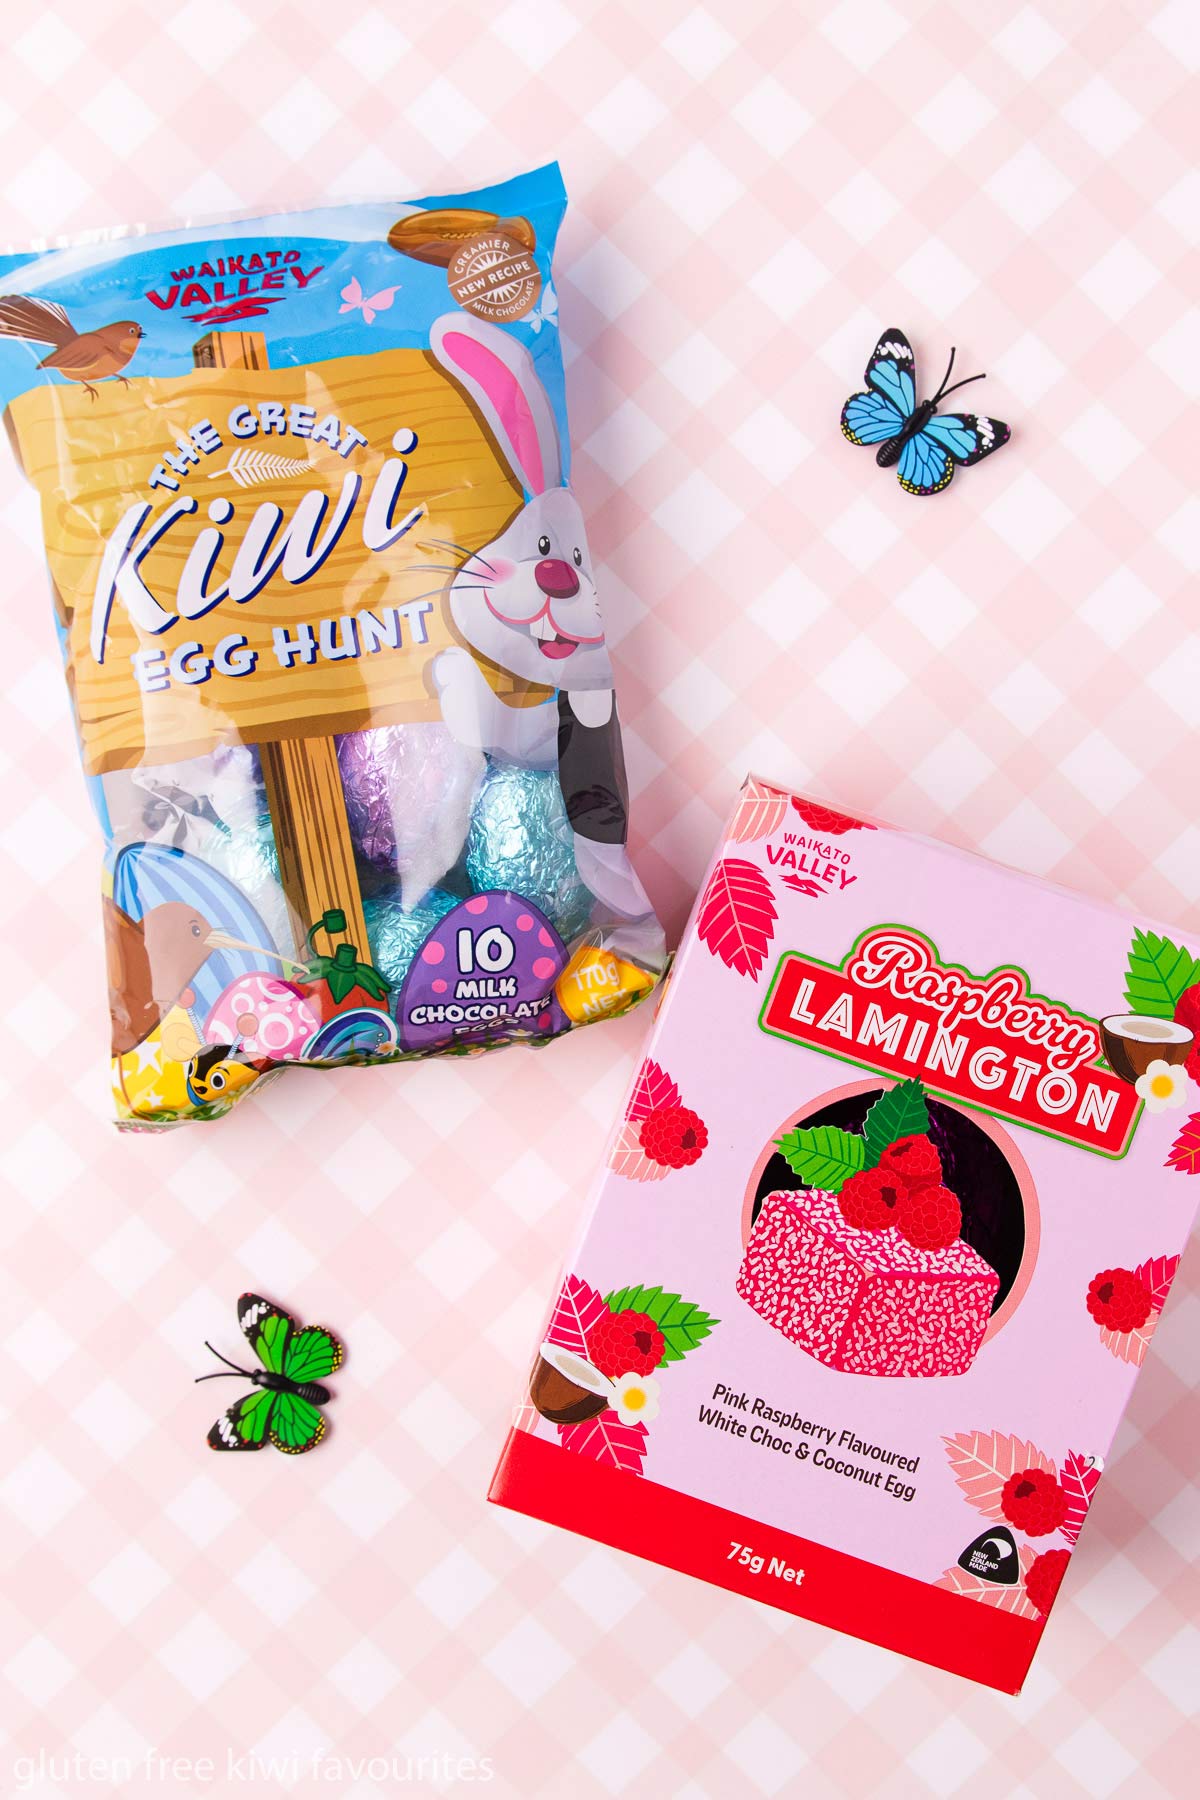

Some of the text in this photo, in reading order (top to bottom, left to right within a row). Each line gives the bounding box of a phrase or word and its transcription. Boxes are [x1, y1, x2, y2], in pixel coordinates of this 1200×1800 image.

[170, 249, 302, 283] WAIKATO
[454, 239, 510, 274] CREAMIER
[144, 265, 326, 312] VALLEY
[457, 261, 531, 298] NEW RECIPE
[472, 280, 535, 317] MILK CHOCOLATE
[147, 401, 369, 492] THE GREAT
[89, 427, 425, 665] Kiwi
[130, 600, 434, 693] EGG HUNT
[765, 844, 859, 891] VALLEY
[782, 832, 852, 866] WAIKATO
[457, 925, 515, 975] 10
[454, 976, 518, 1000] MILK
[571, 960, 620, 992] 170g
[409, 993, 553, 1026] CHOCOLATE
[581, 987, 628, 1018] NET
[850, 935, 1098, 1075] Raspberry
[788, 976, 1122, 1133] LAMINGTON
[711, 1382, 921, 1474] Pink Raspberry Flavoured
[698, 1404, 917, 1502] White Choc & Coconut Egg
[726, 1541, 806, 1587] 75g Net
[968, 1562, 988, 1573] MADE
[971, 1556, 998, 1570] ZEALAND
[972, 1550, 988, 1559] NEW
